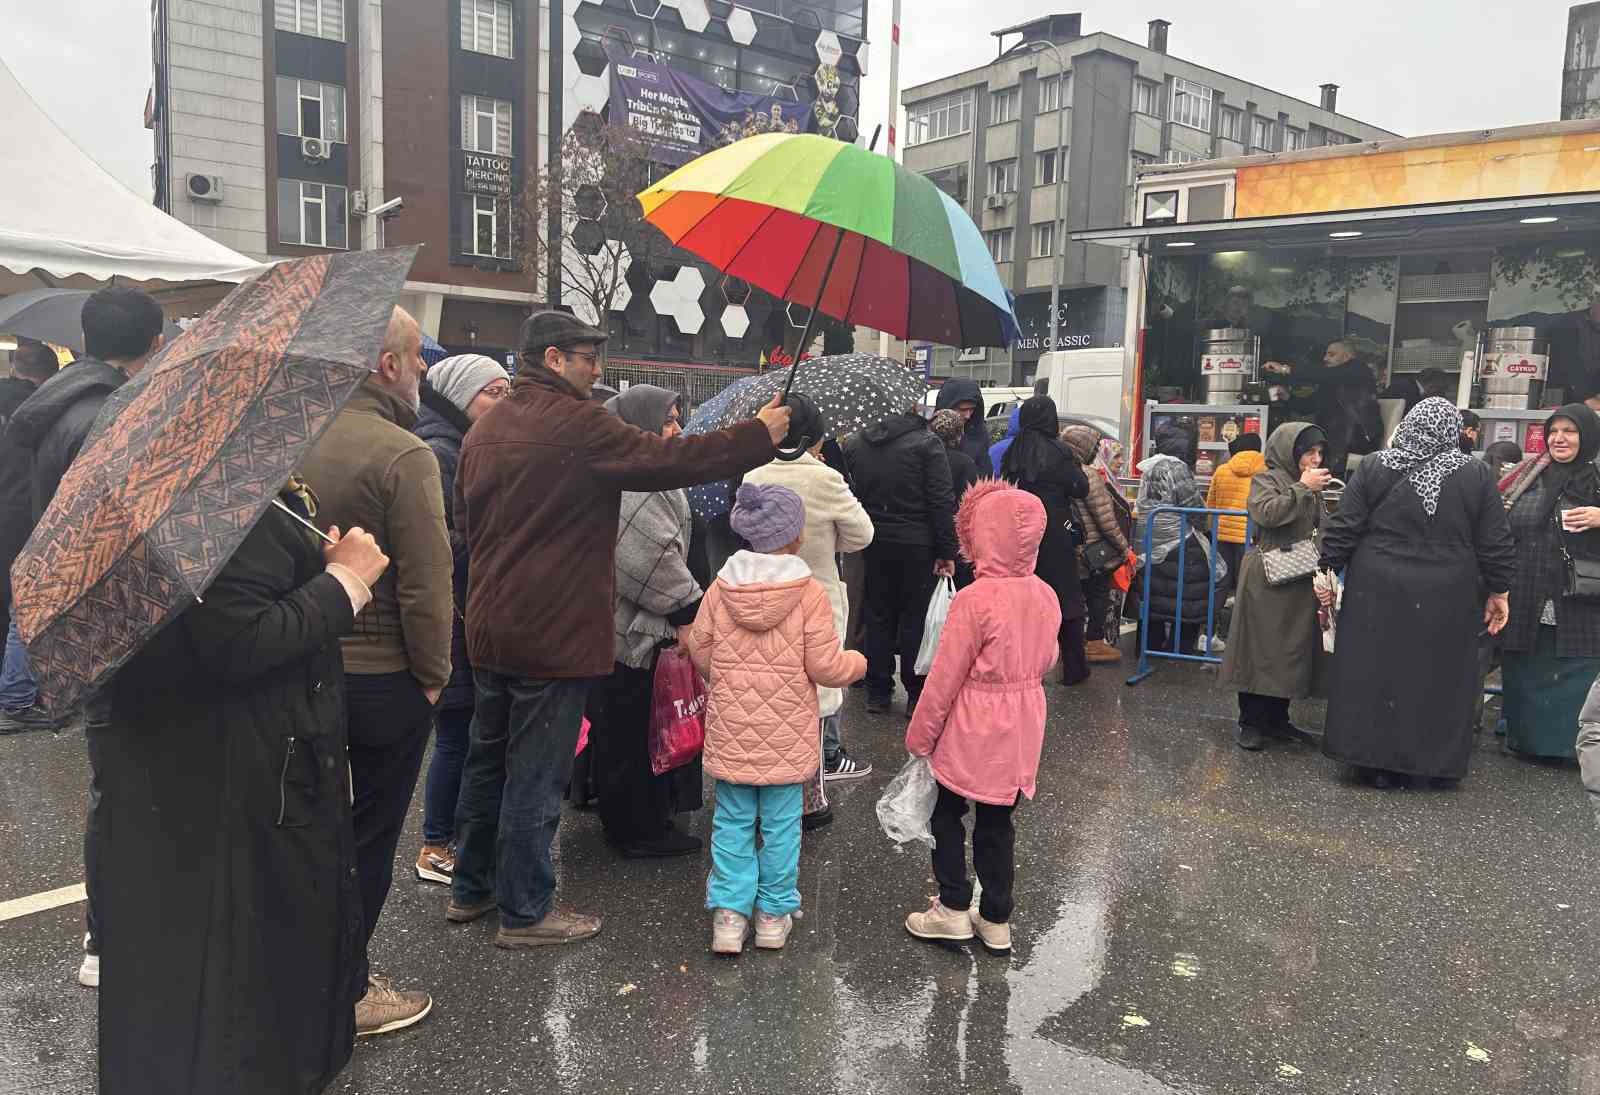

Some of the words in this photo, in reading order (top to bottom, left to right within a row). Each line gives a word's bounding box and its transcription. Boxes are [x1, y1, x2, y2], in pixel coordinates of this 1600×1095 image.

[640, 88, 658, 100] Her
[1017, 337, 1040, 350] MEN
[1043, 334, 1091, 349] CASSIC
